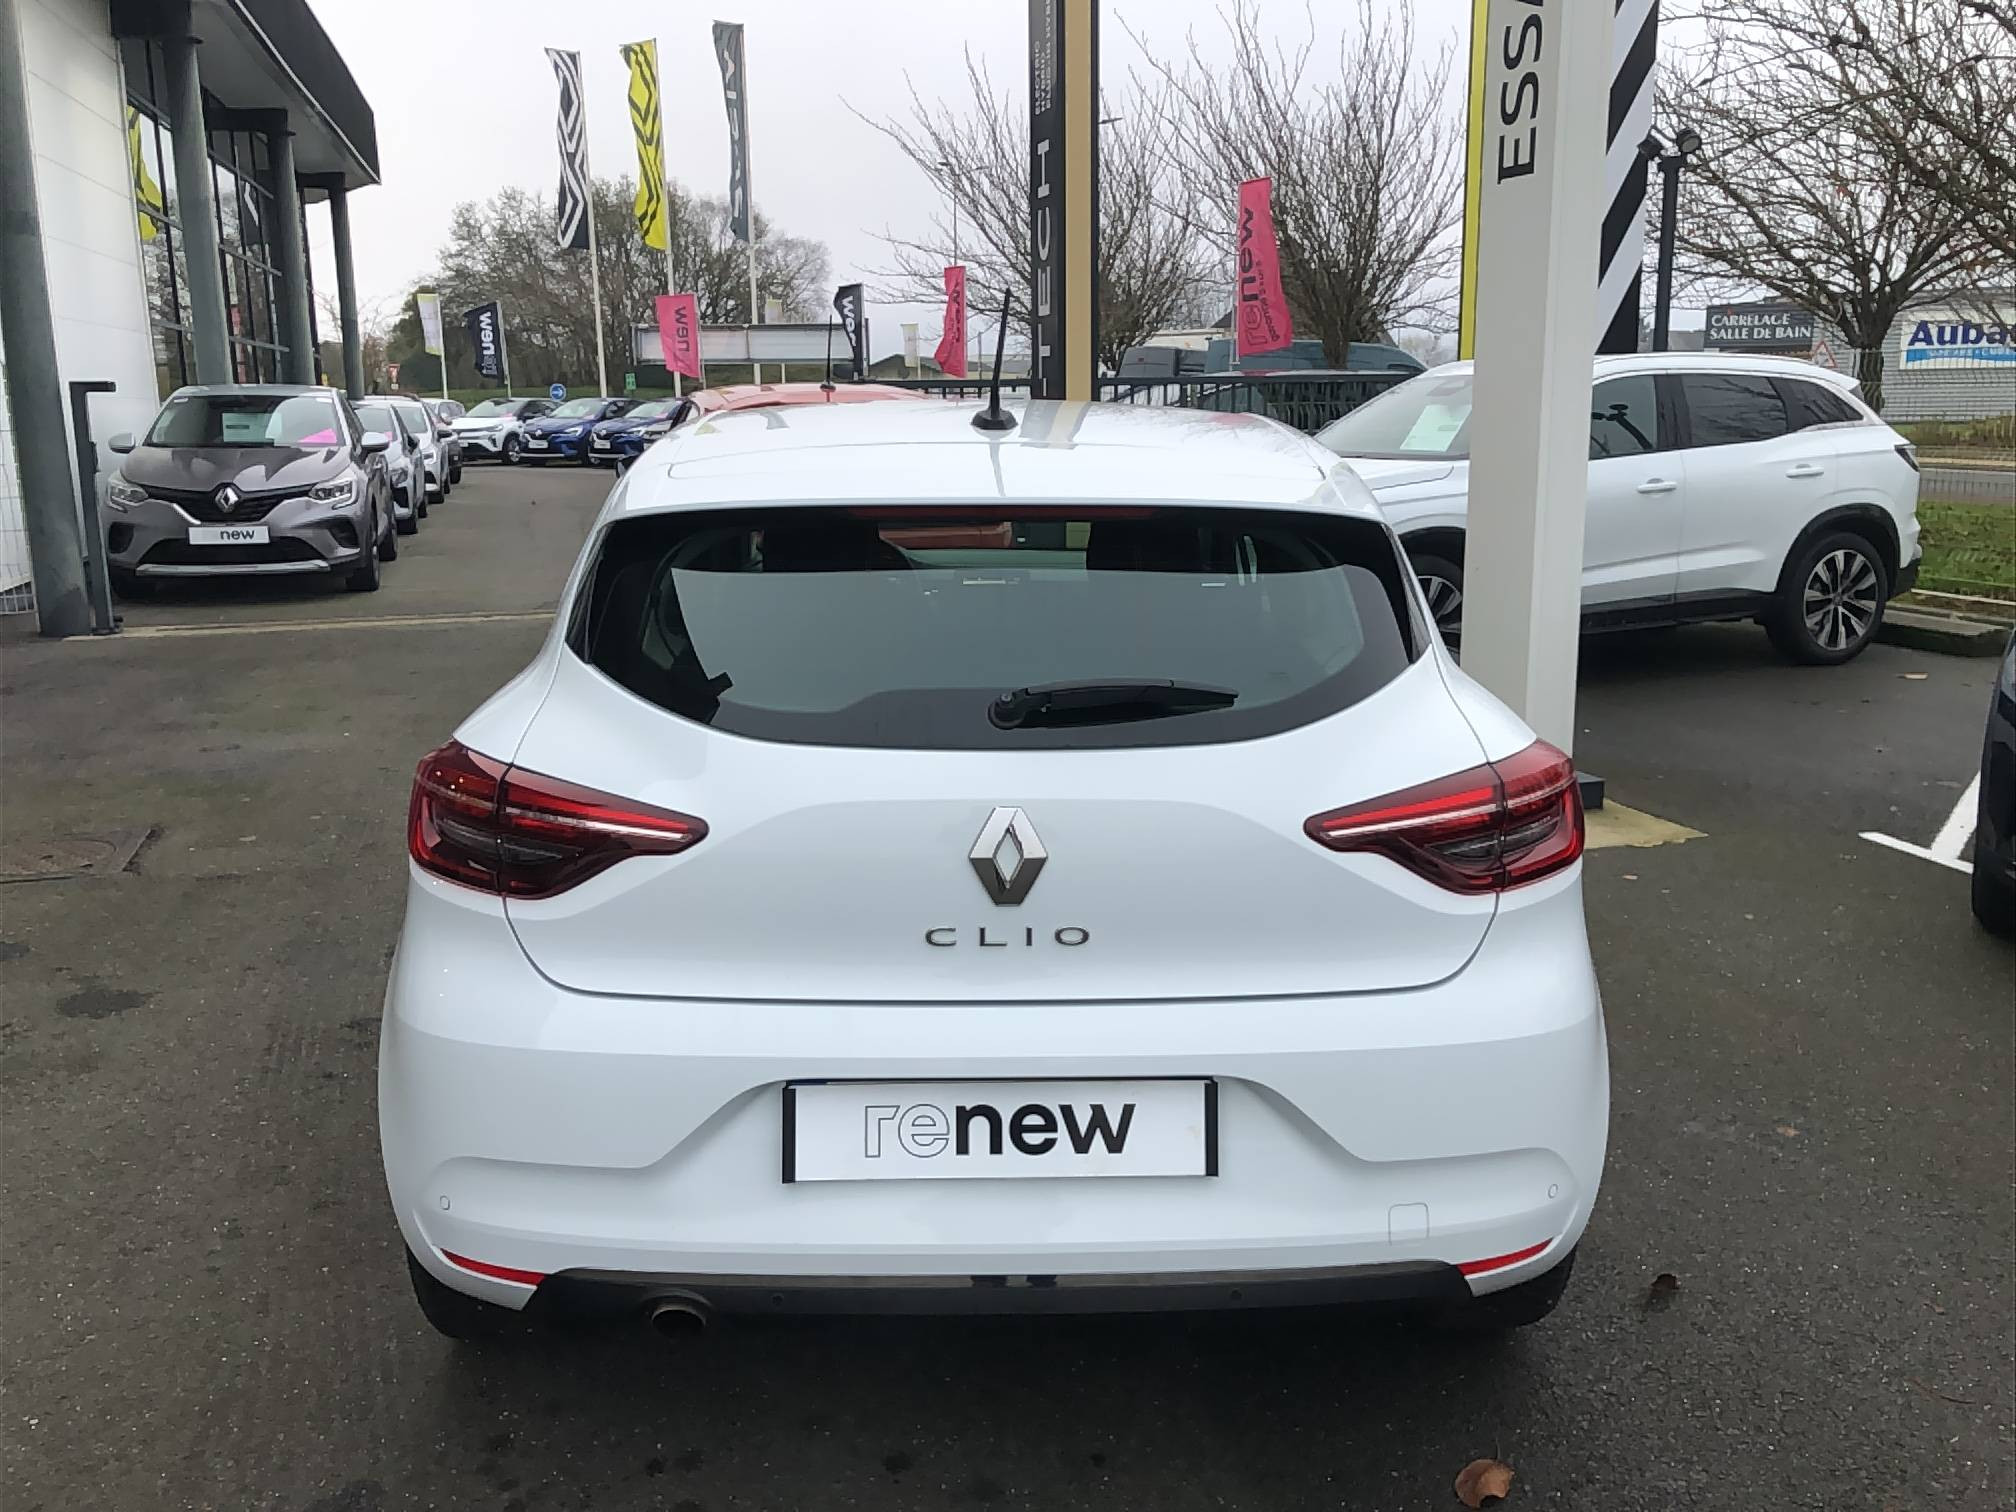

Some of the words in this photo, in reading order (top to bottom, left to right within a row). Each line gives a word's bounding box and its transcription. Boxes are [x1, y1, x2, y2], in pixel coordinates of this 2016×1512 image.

[1497, 0, 1544, 185] ESS
[1240, 207, 1268, 346] renew
[1711, 313, 1791, 327] CARRELAGE
[1709, 327, 1749, 340] SALLE
[1753, 327, 1771, 338] DE
[1775, 326, 1811, 338] BAIN
[1908, 320, 2016, 346] Auba
[220, 530, 255, 540] new
[925, 927, 1090, 947] CLIO
[865, 1103, 1137, 1158] renew
